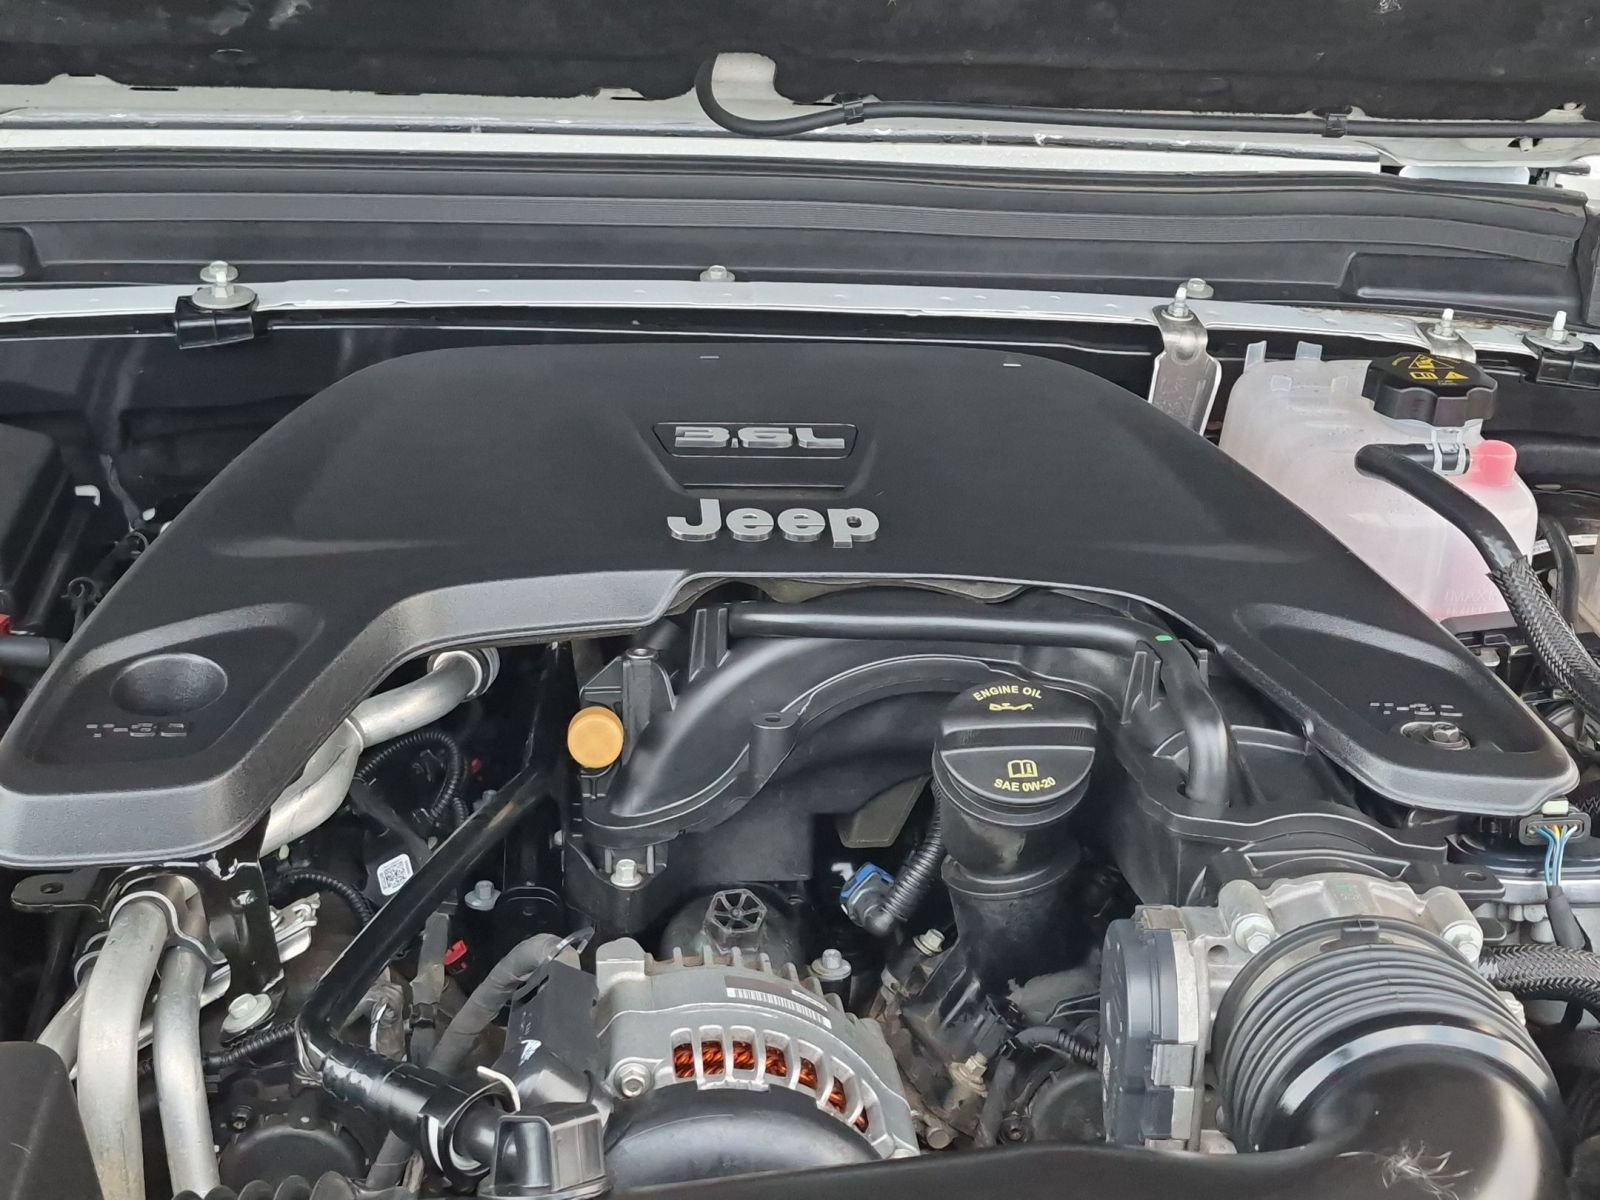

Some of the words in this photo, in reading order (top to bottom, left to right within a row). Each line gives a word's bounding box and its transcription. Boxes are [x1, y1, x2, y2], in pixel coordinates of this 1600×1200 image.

[674, 426, 845, 448] 3.6L
[666, 498, 880, 548] Jeep
[973, 685, 1019, 701] ENGINE
[1022, 687, 1042, 699] OIL
[994, 778, 1020, 792] SAE
[1022, 776, 1056, 792] 0W-20
